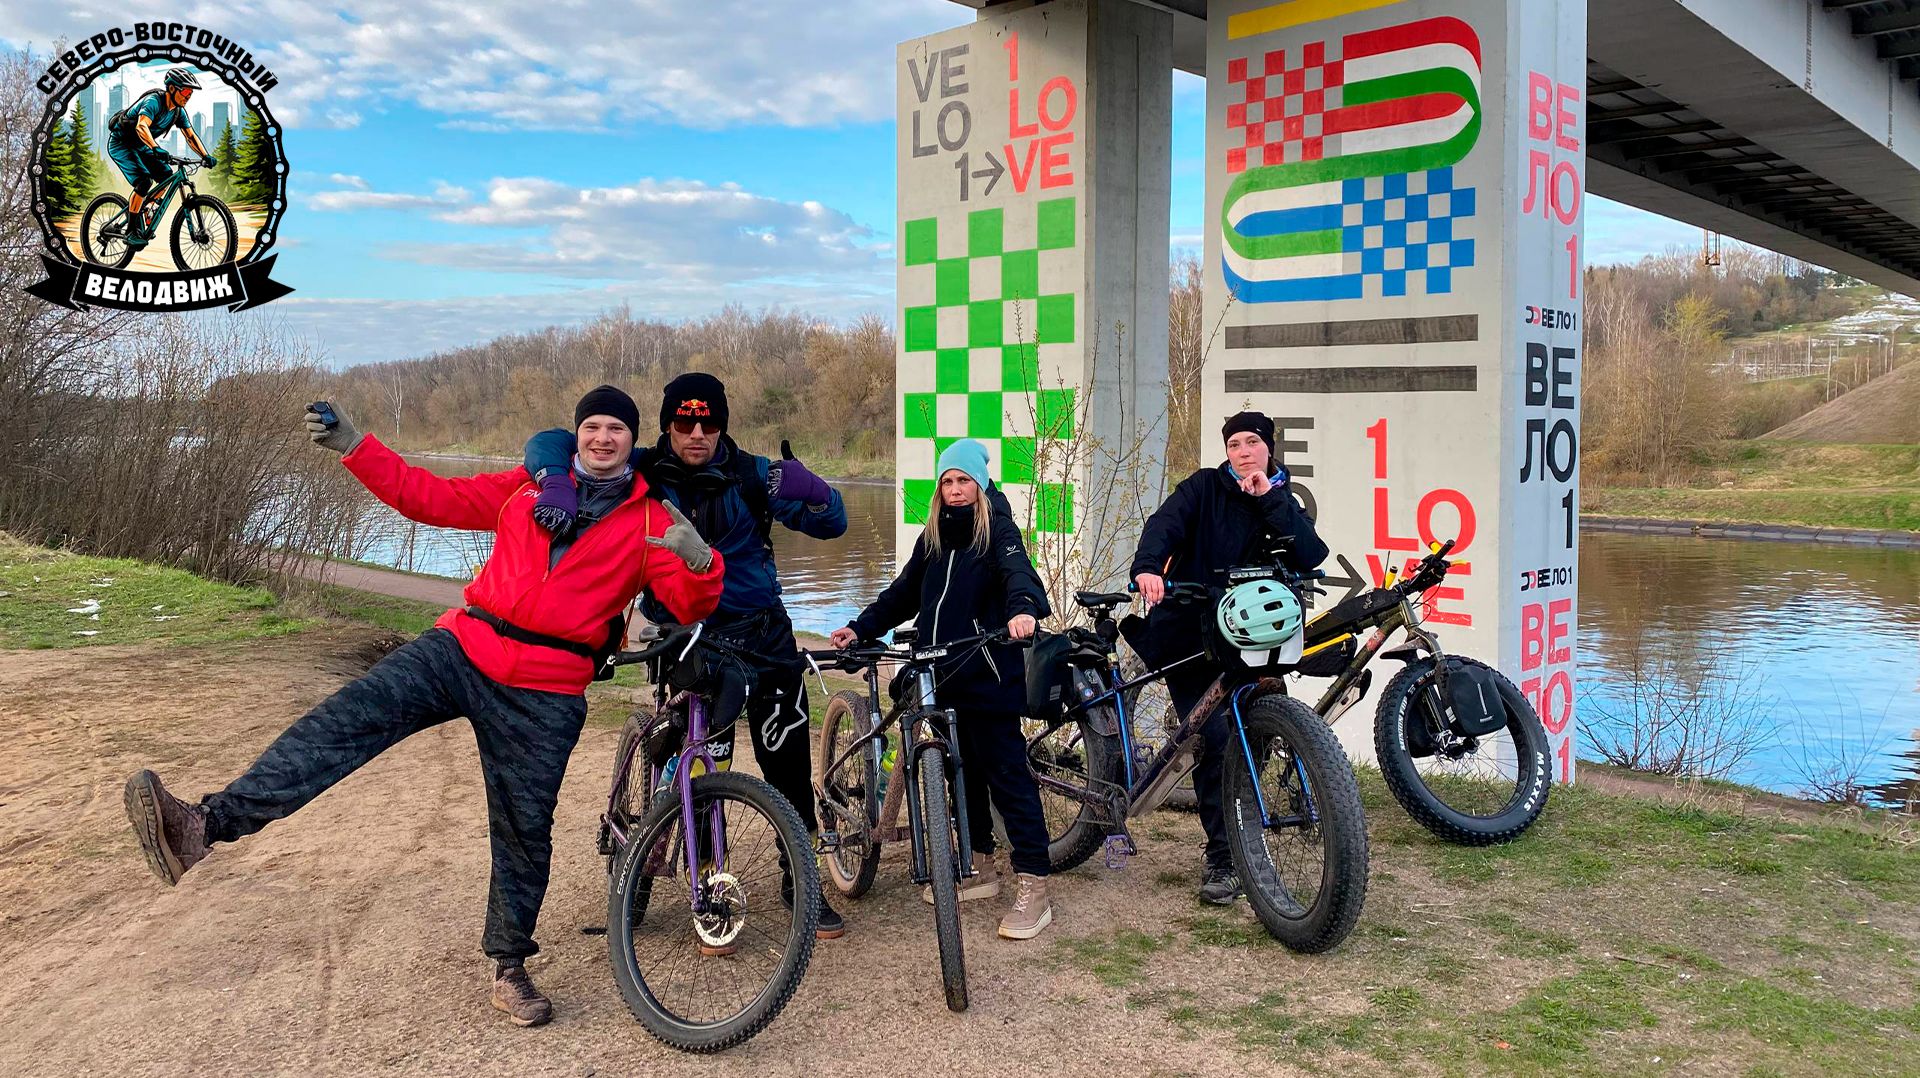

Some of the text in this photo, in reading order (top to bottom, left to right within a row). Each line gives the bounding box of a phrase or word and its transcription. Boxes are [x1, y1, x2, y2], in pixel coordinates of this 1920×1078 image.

[907, 43, 969, 103] VE
[1003, 32, 1018, 81] 1
[912, 101, 972, 158] LO
[1010, 76, 1078, 139] LO
[1528, 71, 1580, 152] ВЕ
[955, 152, 969, 201] 1
[1003, 132, 1074, 193] VE
[1522, 149, 1581, 226] ЛО
[1566, 234, 1577, 299] 1
[1525, 342, 1576, 410] ВЕ
[676, 408, 710, 416] Red Bull
[1366, 418, 1387, 479] 1
[1520, 419, 1577, 483] ЛО
[1374, 487, 1476, 555] LO
[1562, 489, 1574, 549] 1
[1521, 598, 1571, 672] ВЕ
[1523, 751, 1545, 812] MAXXIS
[1558, 736, 1569, 784] 1
[616, 824, 652, 896] CONTINENTAL
